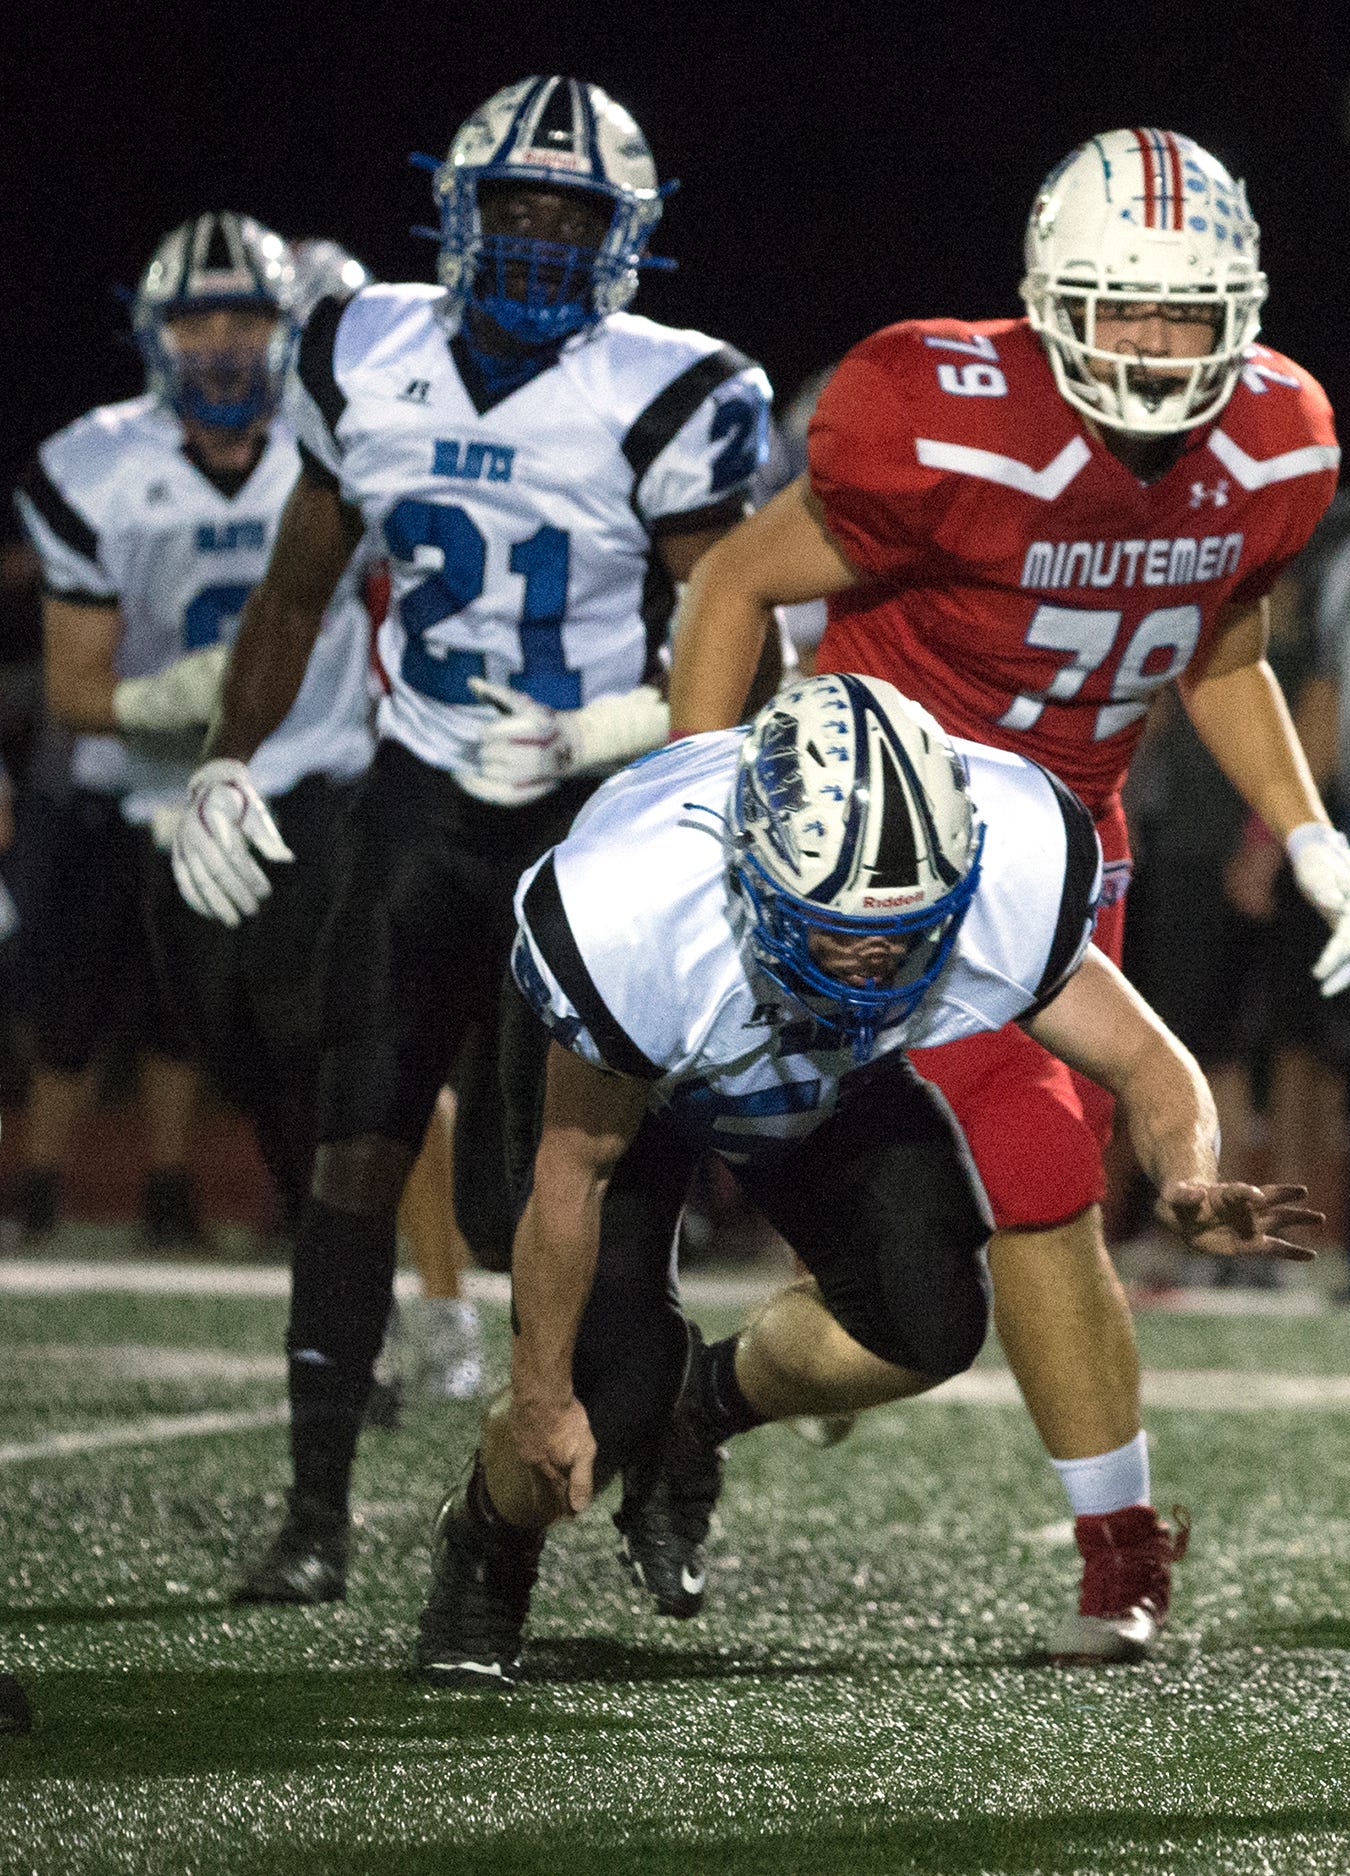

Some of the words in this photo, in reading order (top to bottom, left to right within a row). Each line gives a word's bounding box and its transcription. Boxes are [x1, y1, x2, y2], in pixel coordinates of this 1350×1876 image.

[384, 499, 583, 712] 21
[1020, 532, 1244, 589] MINUTEMEN
[998, 601, 1202, 743] 79
